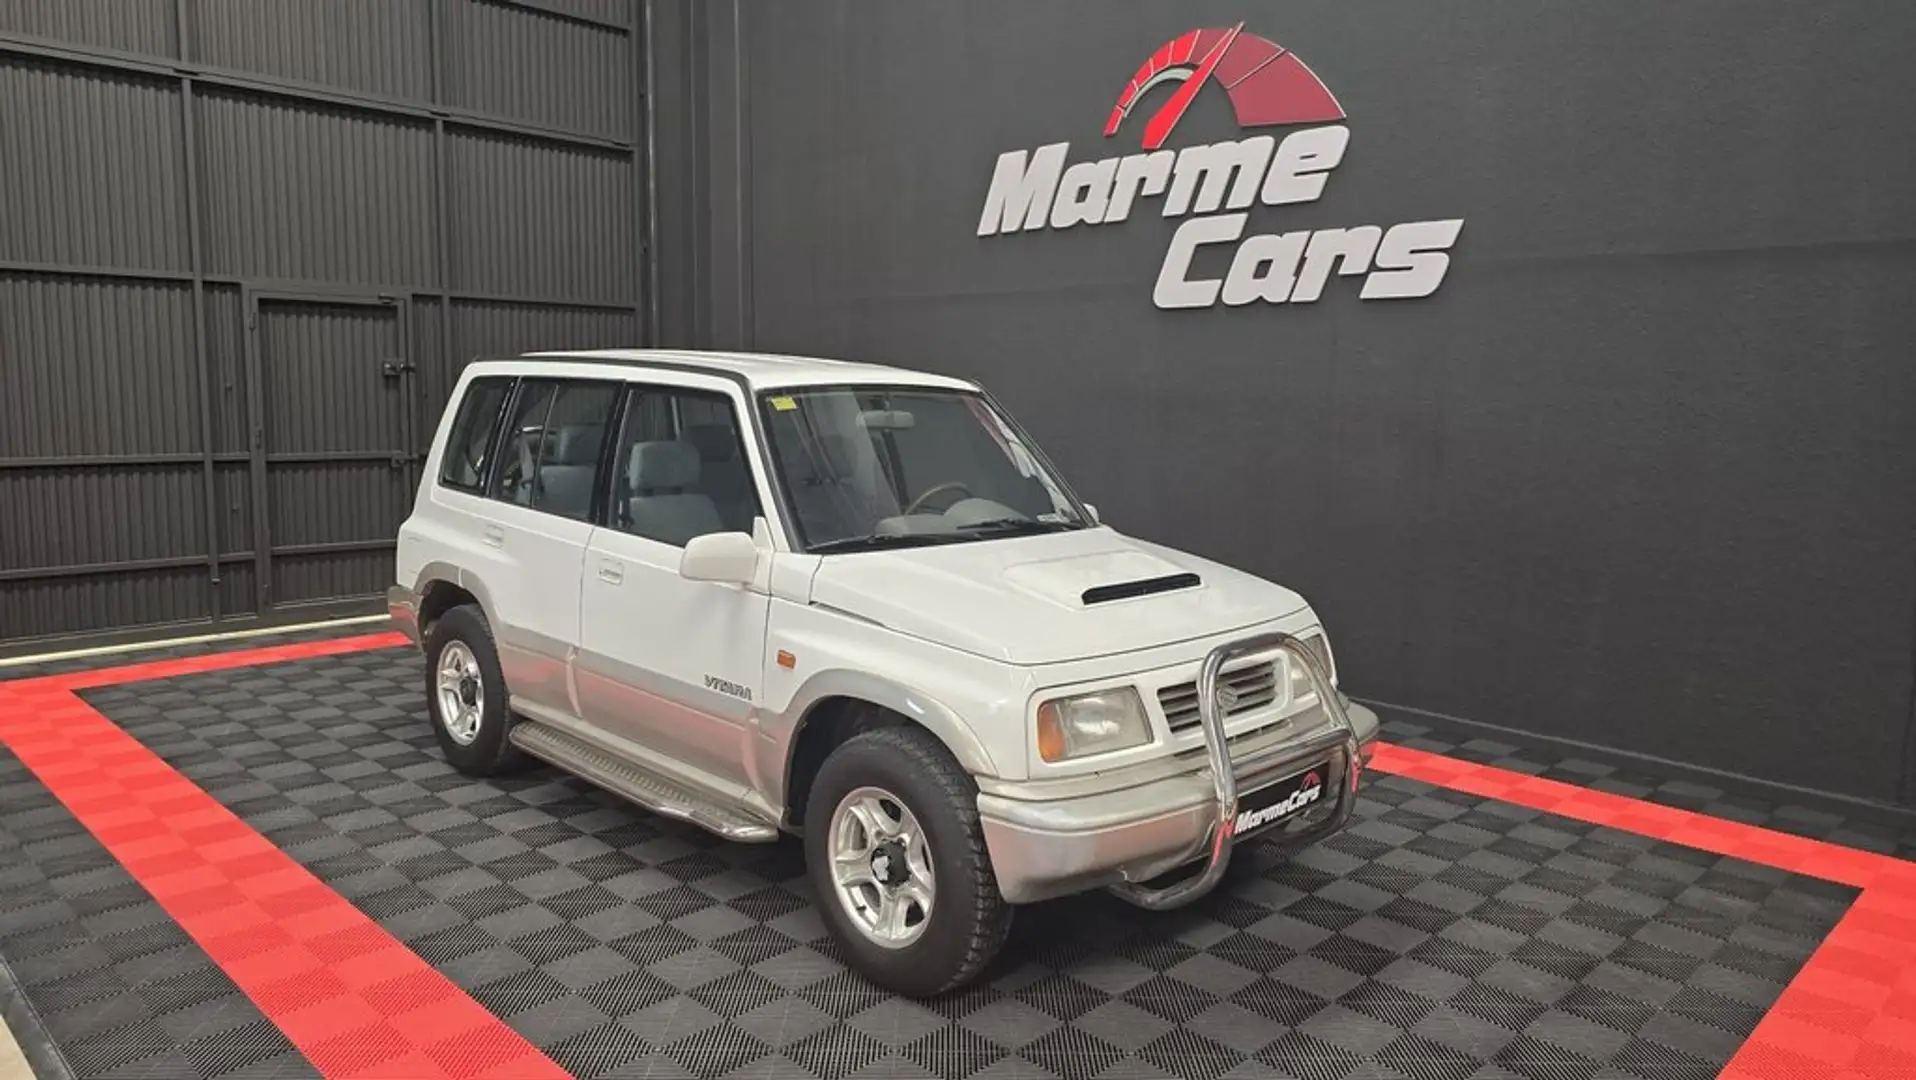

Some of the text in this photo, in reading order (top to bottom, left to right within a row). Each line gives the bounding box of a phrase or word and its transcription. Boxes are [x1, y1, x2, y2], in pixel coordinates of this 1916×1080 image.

[977, 125, 1350, 236] Marme
[1153, 213, 1464, 309] Cars
[704, 673, 752, 701] VITARA
